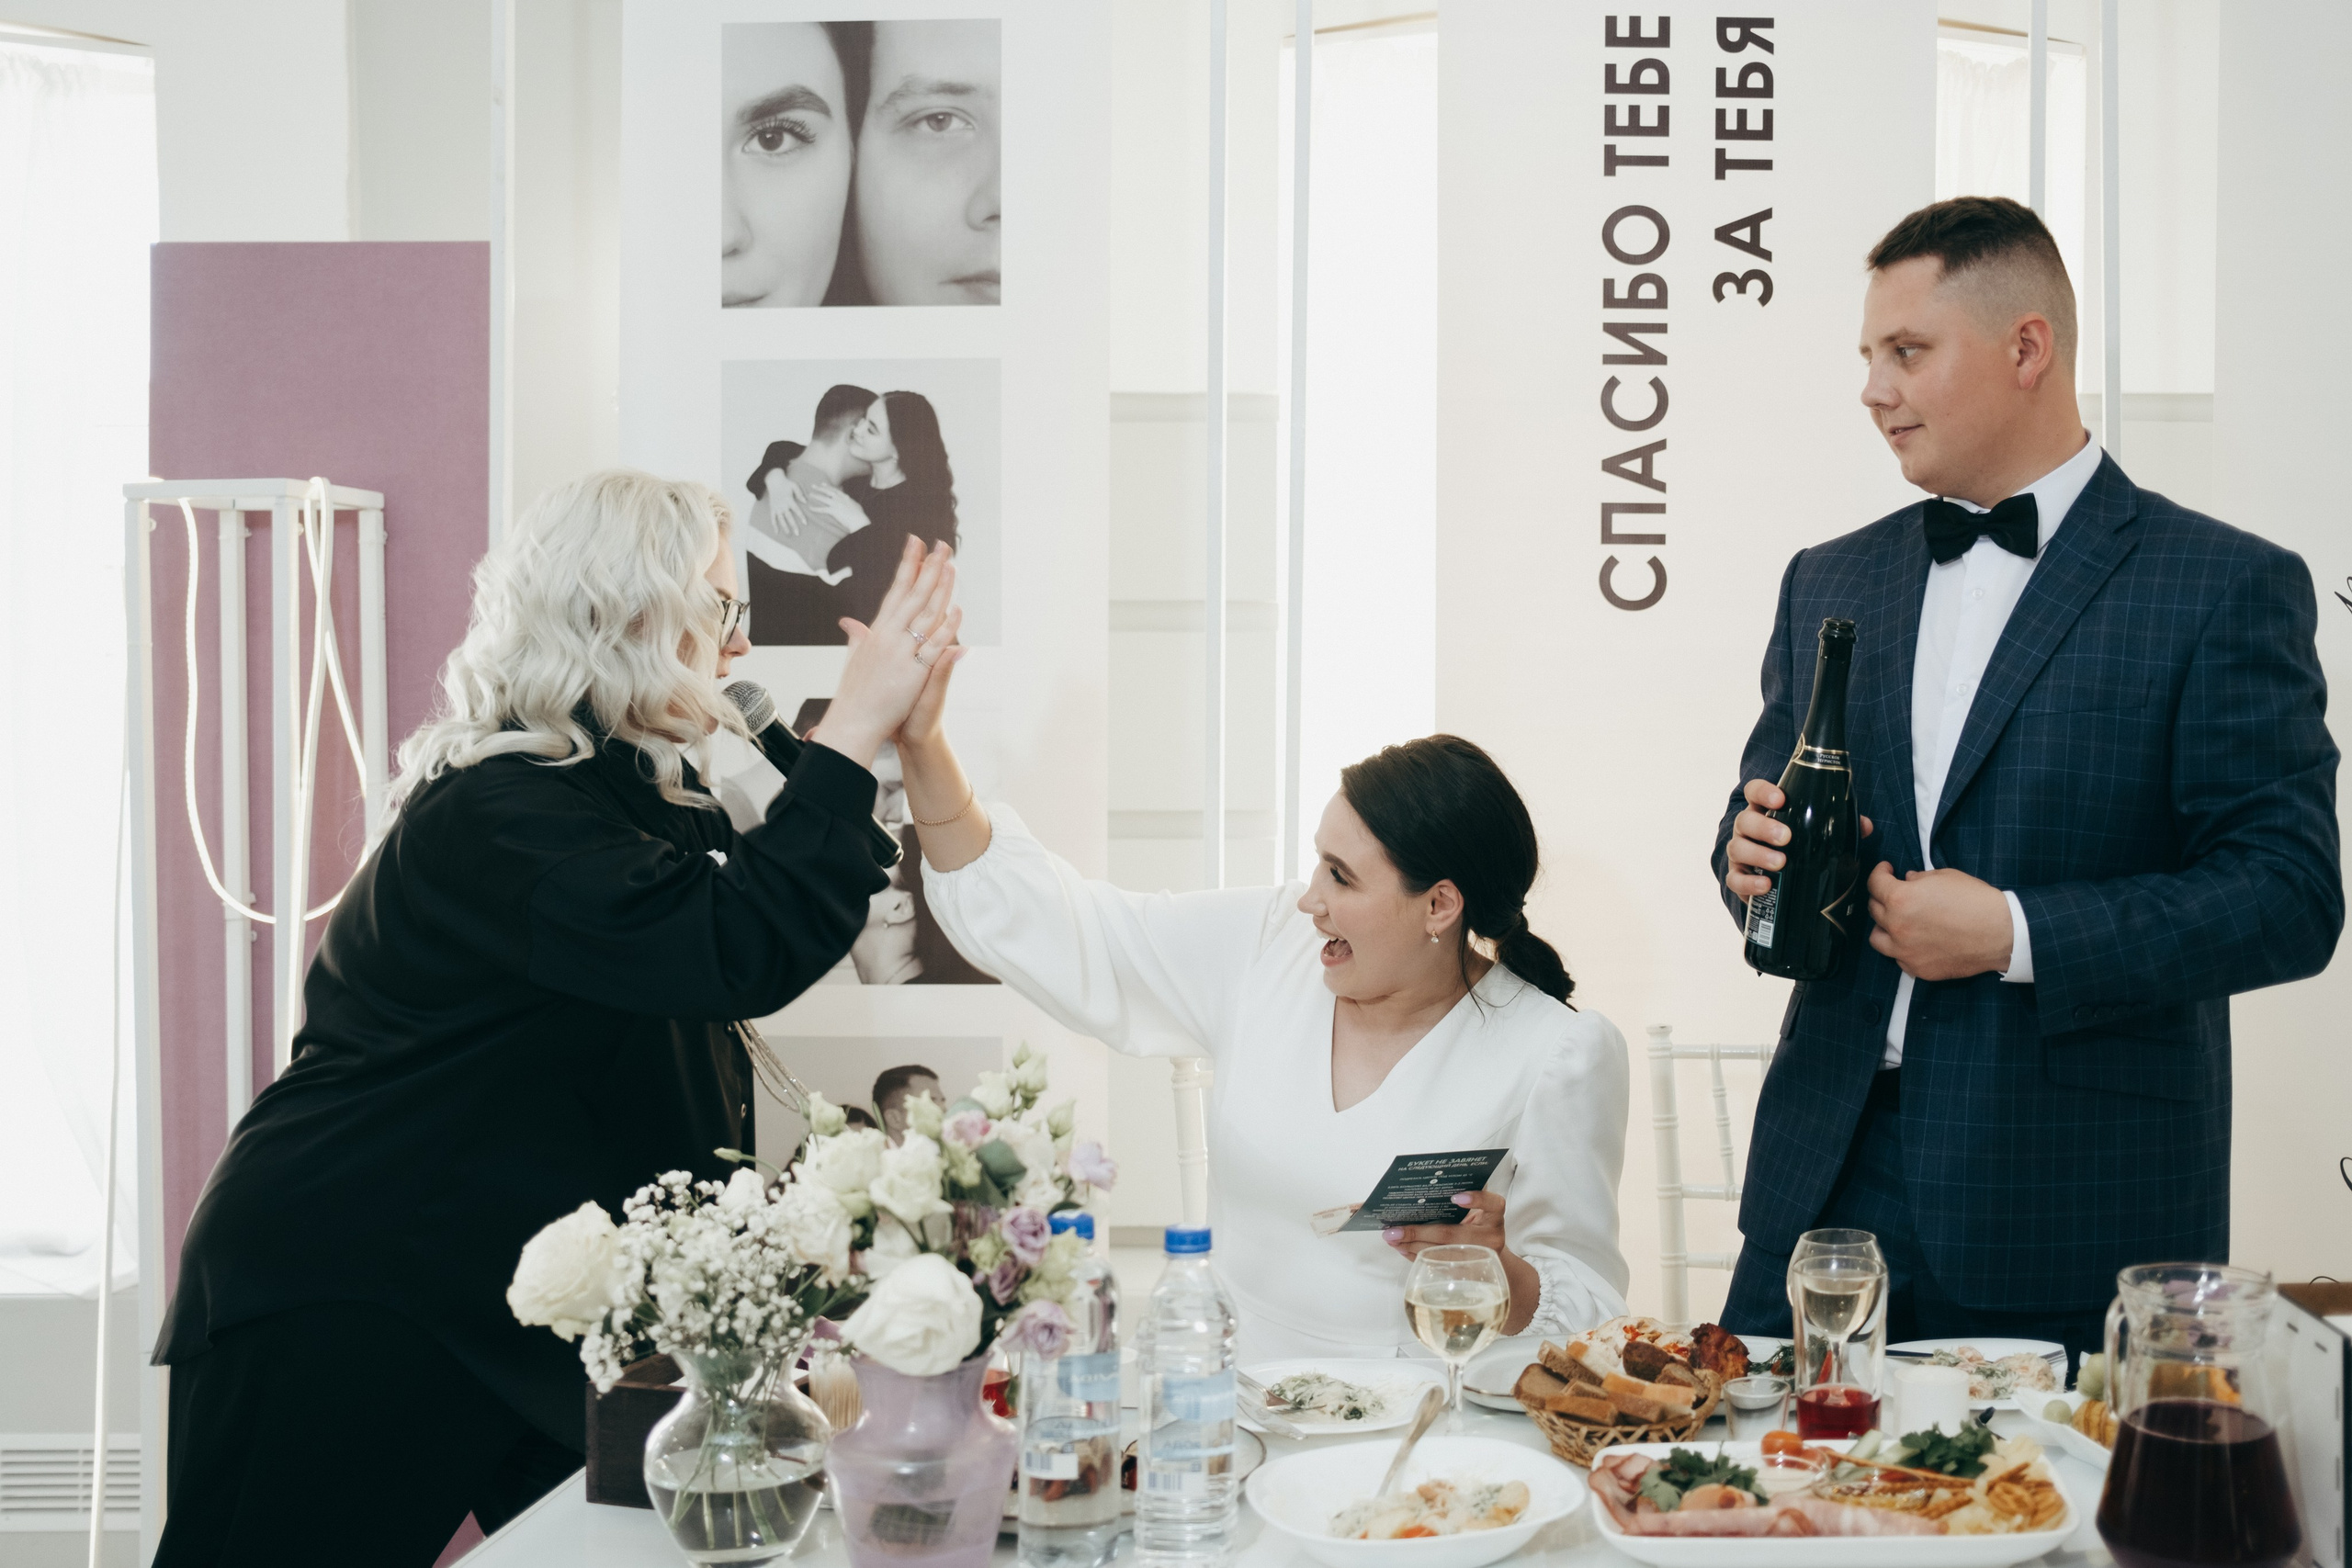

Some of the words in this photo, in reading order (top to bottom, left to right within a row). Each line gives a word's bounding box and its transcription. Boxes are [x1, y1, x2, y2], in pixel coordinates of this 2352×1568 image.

[1603, 15, 1671, 175] ТЕБЕ
[1714, 17, 1774, 180] ТЕБЯ
[1712, 207, 1774, 308] ЗА
[1599, 204, 1670, 611] СПАСИБО
[1407, 1159, 1435, 1168] БУКЕТ
[1448, 1156, 1487, 1164] ЗАВЯНЕТ
